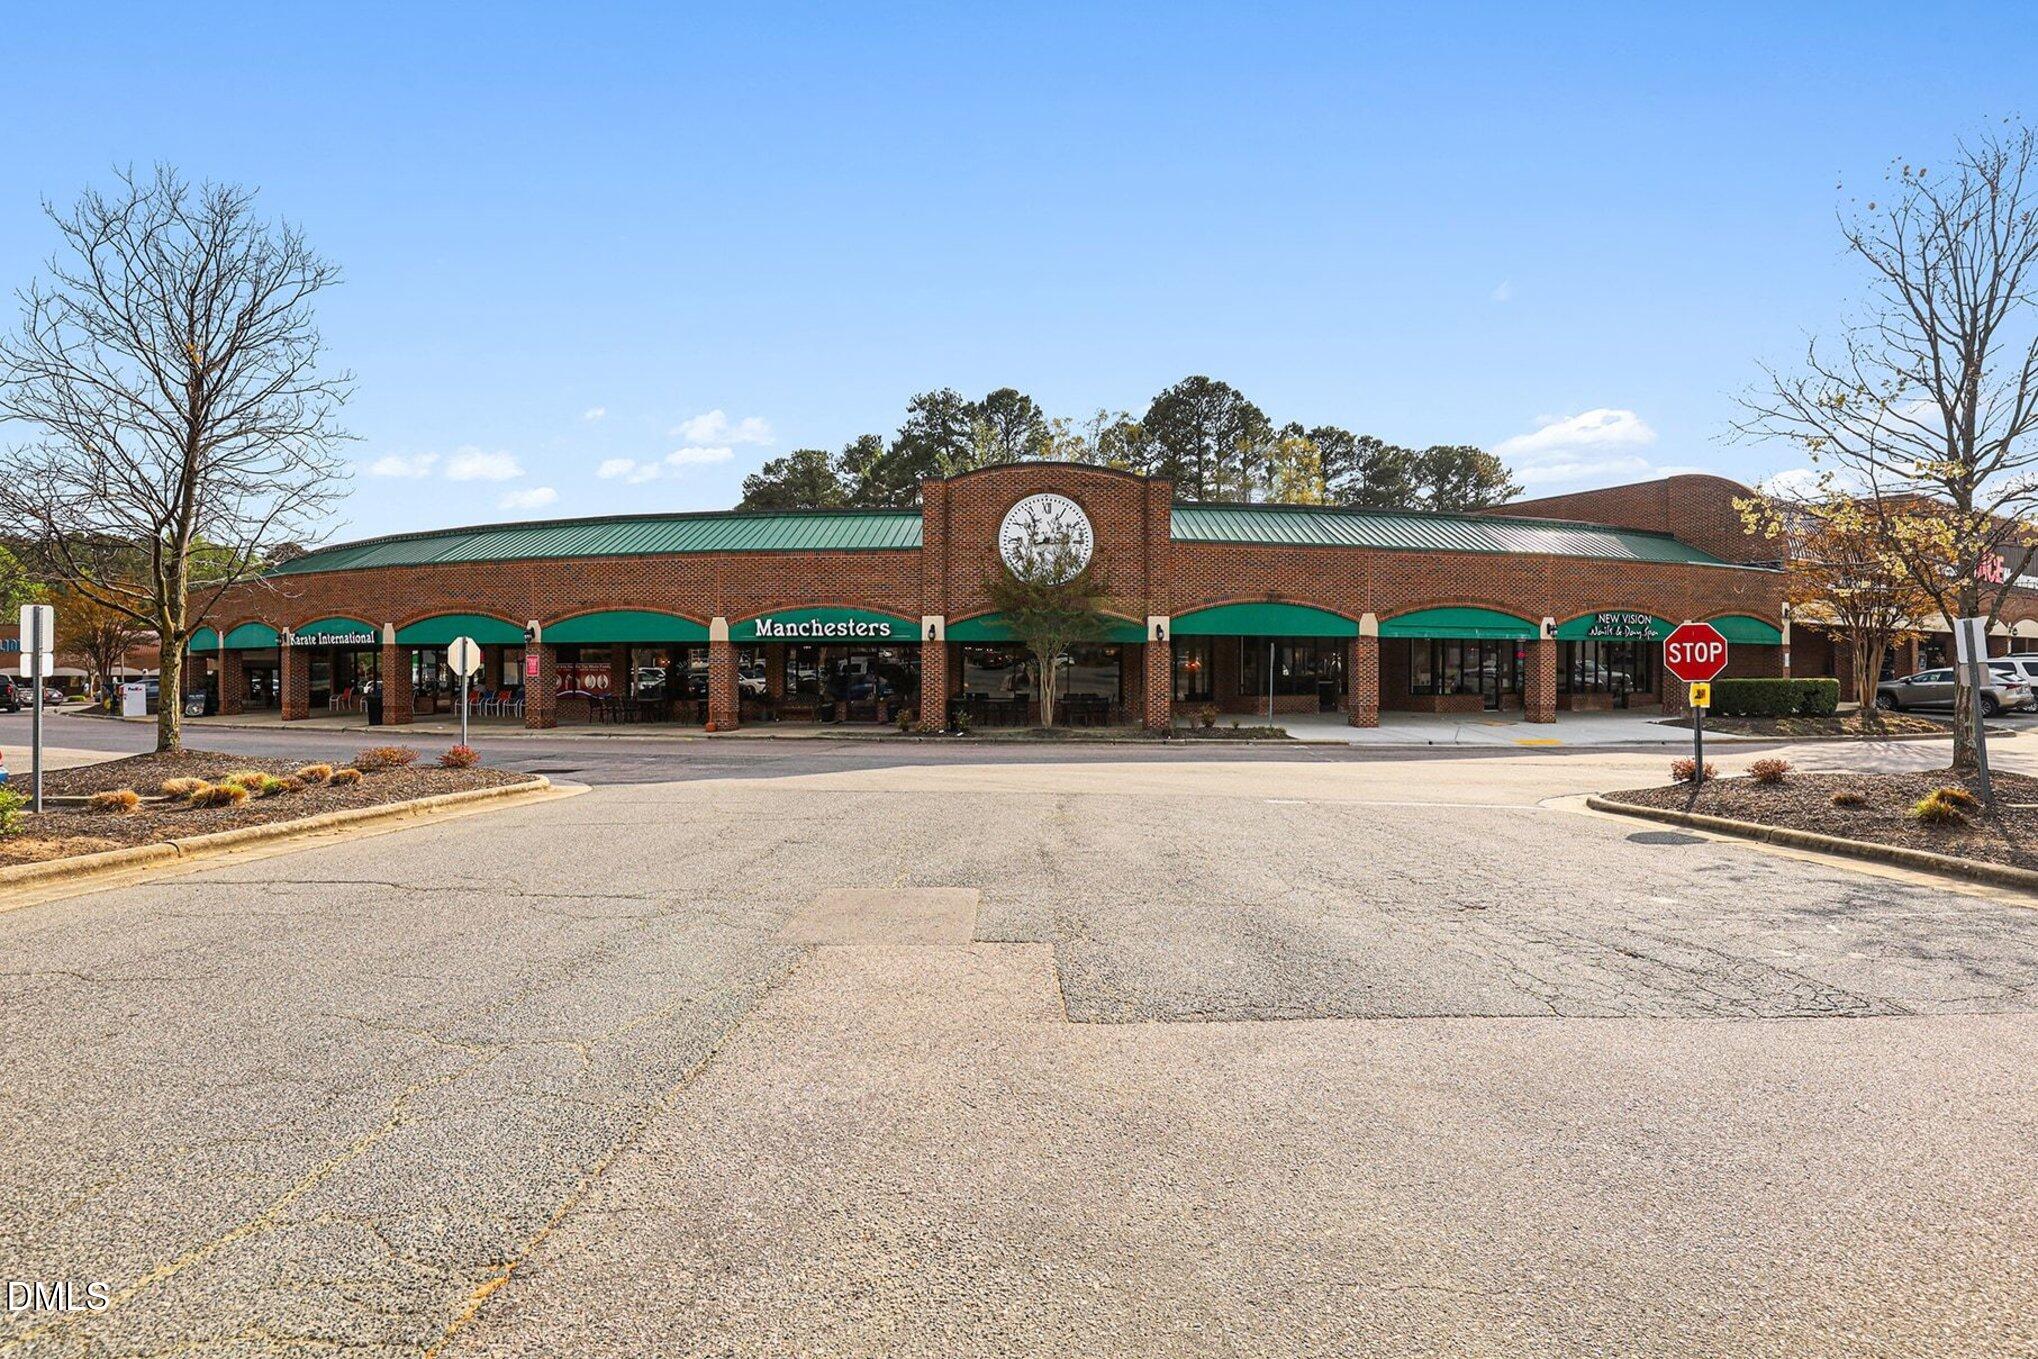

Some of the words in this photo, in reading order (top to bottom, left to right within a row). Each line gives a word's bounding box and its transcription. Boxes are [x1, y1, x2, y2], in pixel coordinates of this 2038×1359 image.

[755, 618, 891, 637] Manchesters
[1598, 613, 1620, 624] NEW
[1622, 613, 1652, 625] VISION
[289, 633, 317, 647] Karate
[318, 630, 375, 646] International
[1669, 642, 1723, 664] STOP
